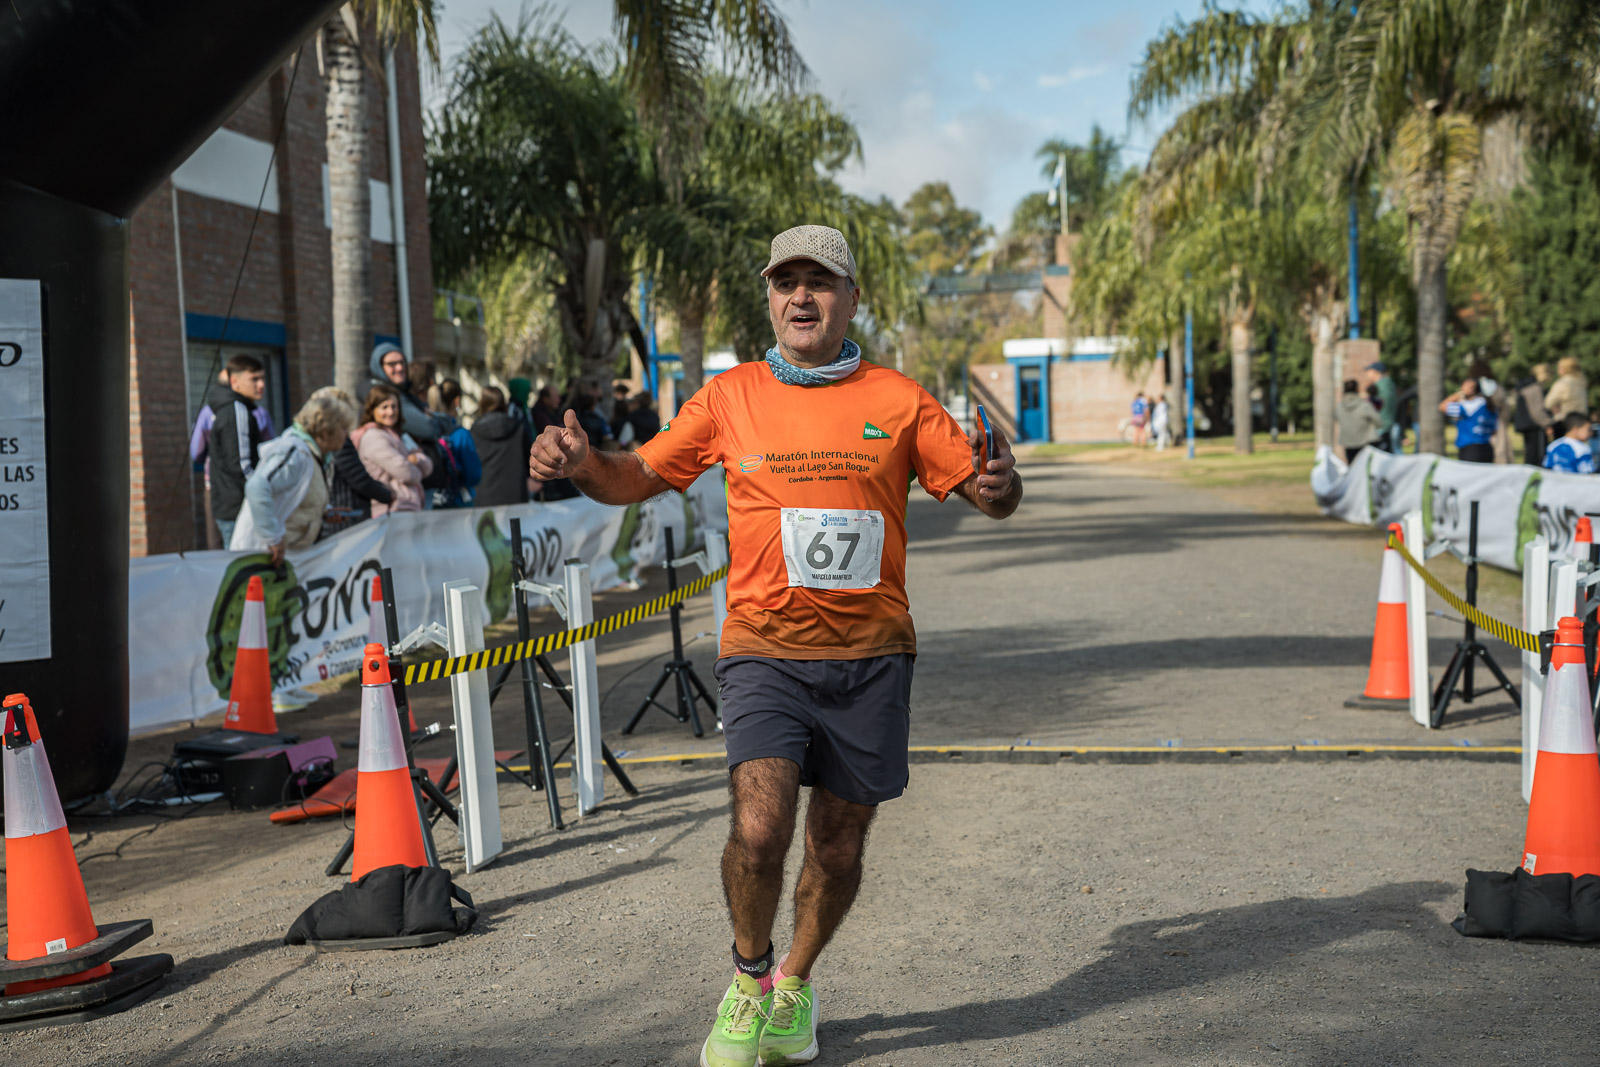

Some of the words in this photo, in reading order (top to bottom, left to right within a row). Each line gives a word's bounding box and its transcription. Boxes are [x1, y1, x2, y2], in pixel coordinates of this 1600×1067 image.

[0, 437, 19, 454] ES
[765, 451, 808, 463] Maratón
[810, 450, 880, 464] Internacional
[4, 465, 35, 483] LAS
[769, 464, 796, 474] Vuelta
[797, 463, 806, 472] al
[807, 463, 827, 473] Lago
[828, 461, 844, 471] San
[845, 461, 870, 473] Roque
[0, 493, 19, 511] OS
[806, 532, 861, 570] 67
